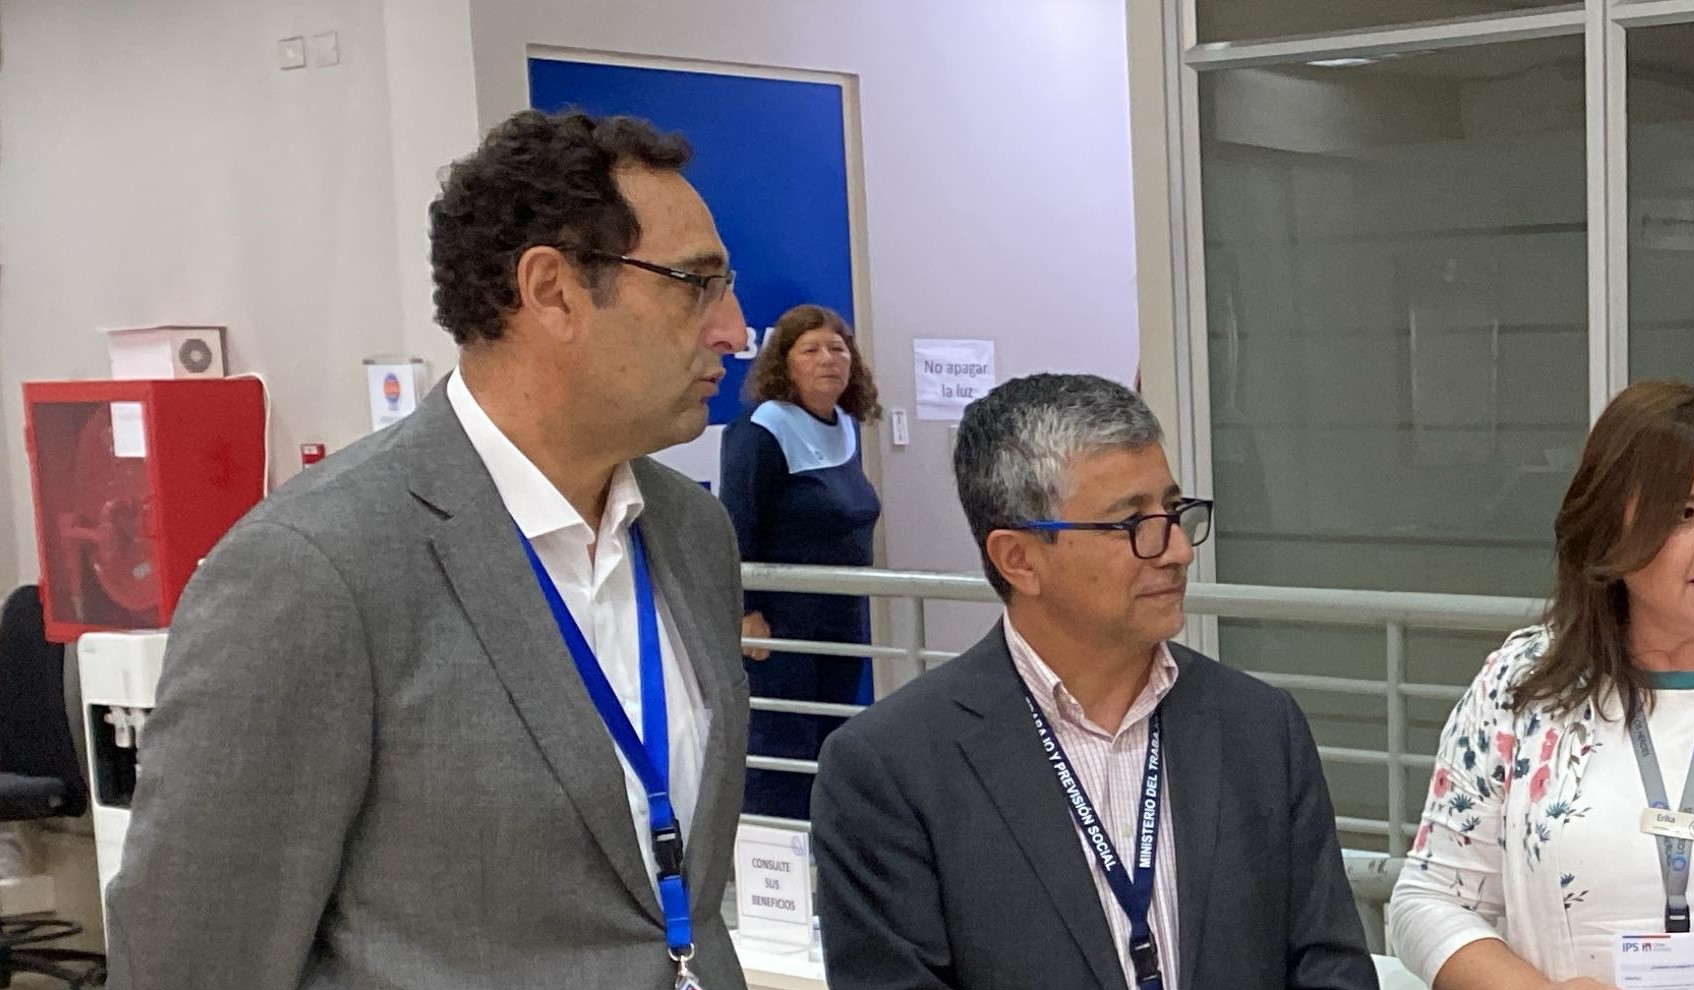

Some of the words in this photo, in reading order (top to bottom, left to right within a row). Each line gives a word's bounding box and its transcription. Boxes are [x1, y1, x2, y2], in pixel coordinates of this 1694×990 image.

[924, 360, 943, 375] No
[946, 362, 989, 378] apagar
[941, 383, 954, 398] la
[956, 383, 975, 399] luz
[1149, 715, 1160, 770] TRABA
[1049, 751, 1062, 761] Y
[1053, 762, 1095, 825] PREVISIÓN
[1146, 774, 1158, 797] DEL
[1139, 799, 1156, 869] MINISTERIO
[1088, 825, 1117, 872] SOCIAL
[752, 857, 791, 873] CONSULTE
[764, 877, 780, 890] SUS
[751, 895, 796, 911] BENEFICIOS
[1622, 942, 1639, 952] IPS
